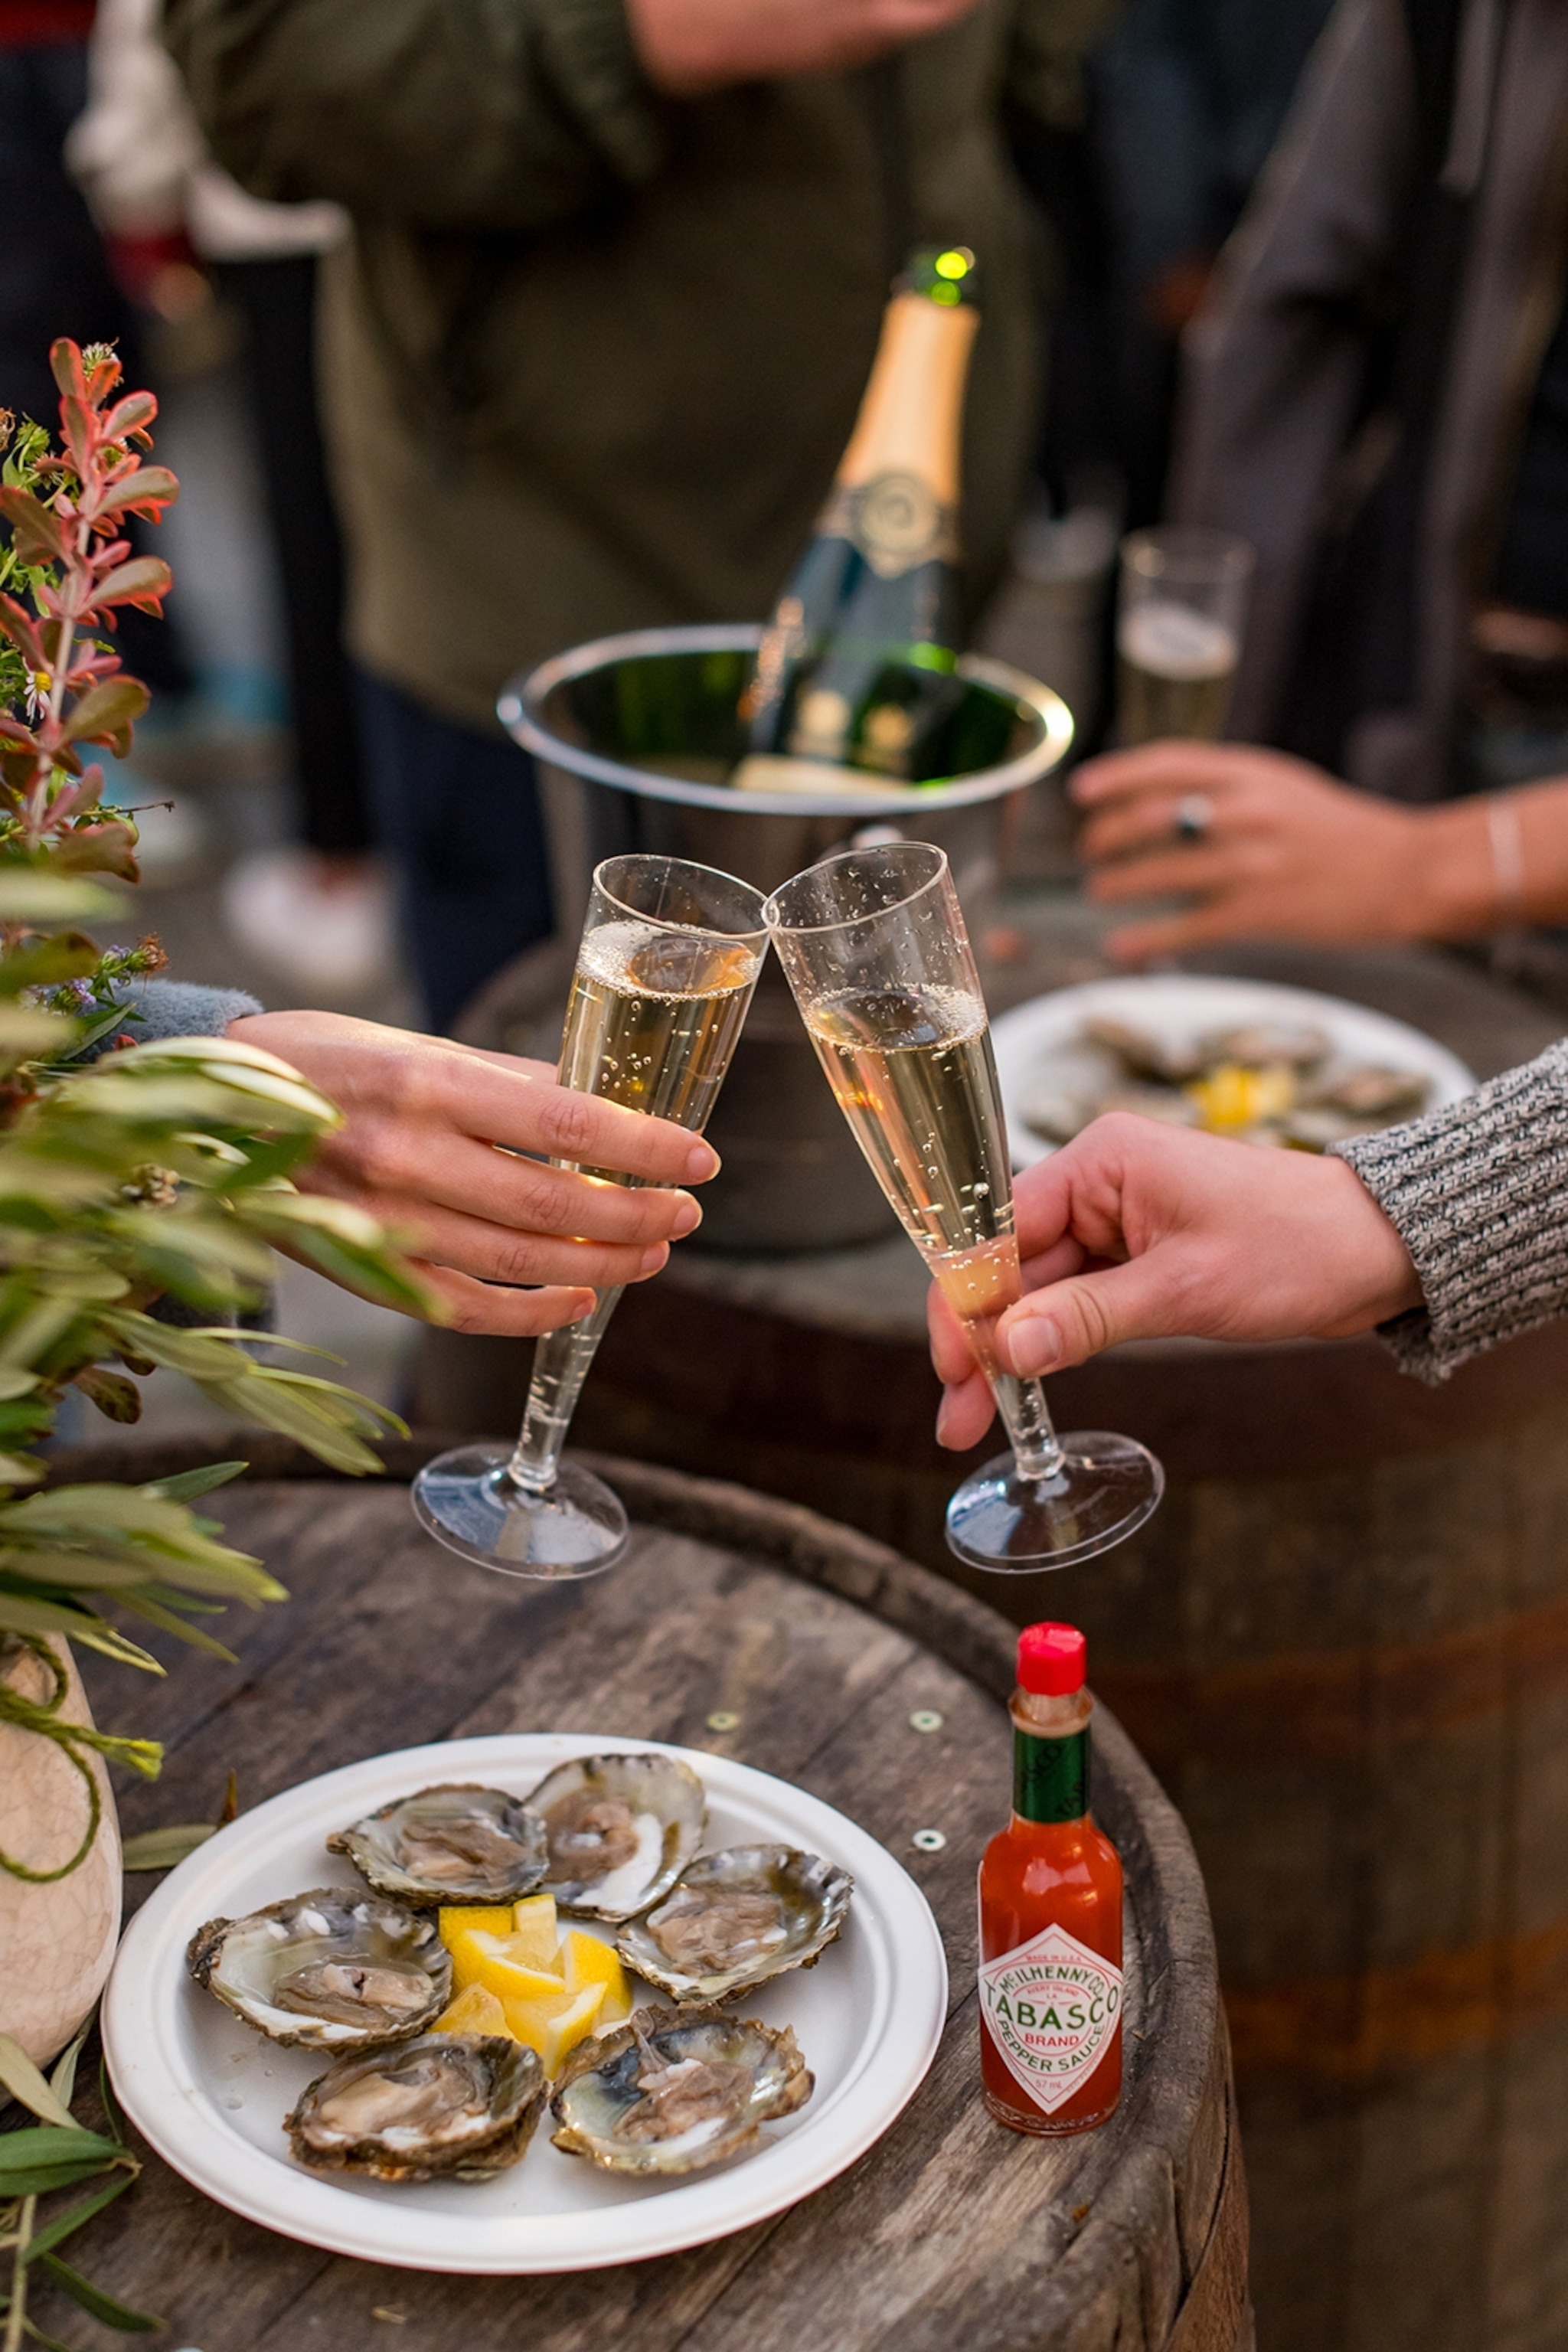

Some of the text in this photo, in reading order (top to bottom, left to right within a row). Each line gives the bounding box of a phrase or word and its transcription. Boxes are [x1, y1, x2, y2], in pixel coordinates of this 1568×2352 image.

[984, 1979, 1119, 2030] TABASCO
[998, 2020, 1052, 2072] PEPPER
[1058, 2024, 1105, 2072] SAUCE
[1024, 2033, 1080, 2047] BRAND
[1036, 2079, 1047, 2089] 57
